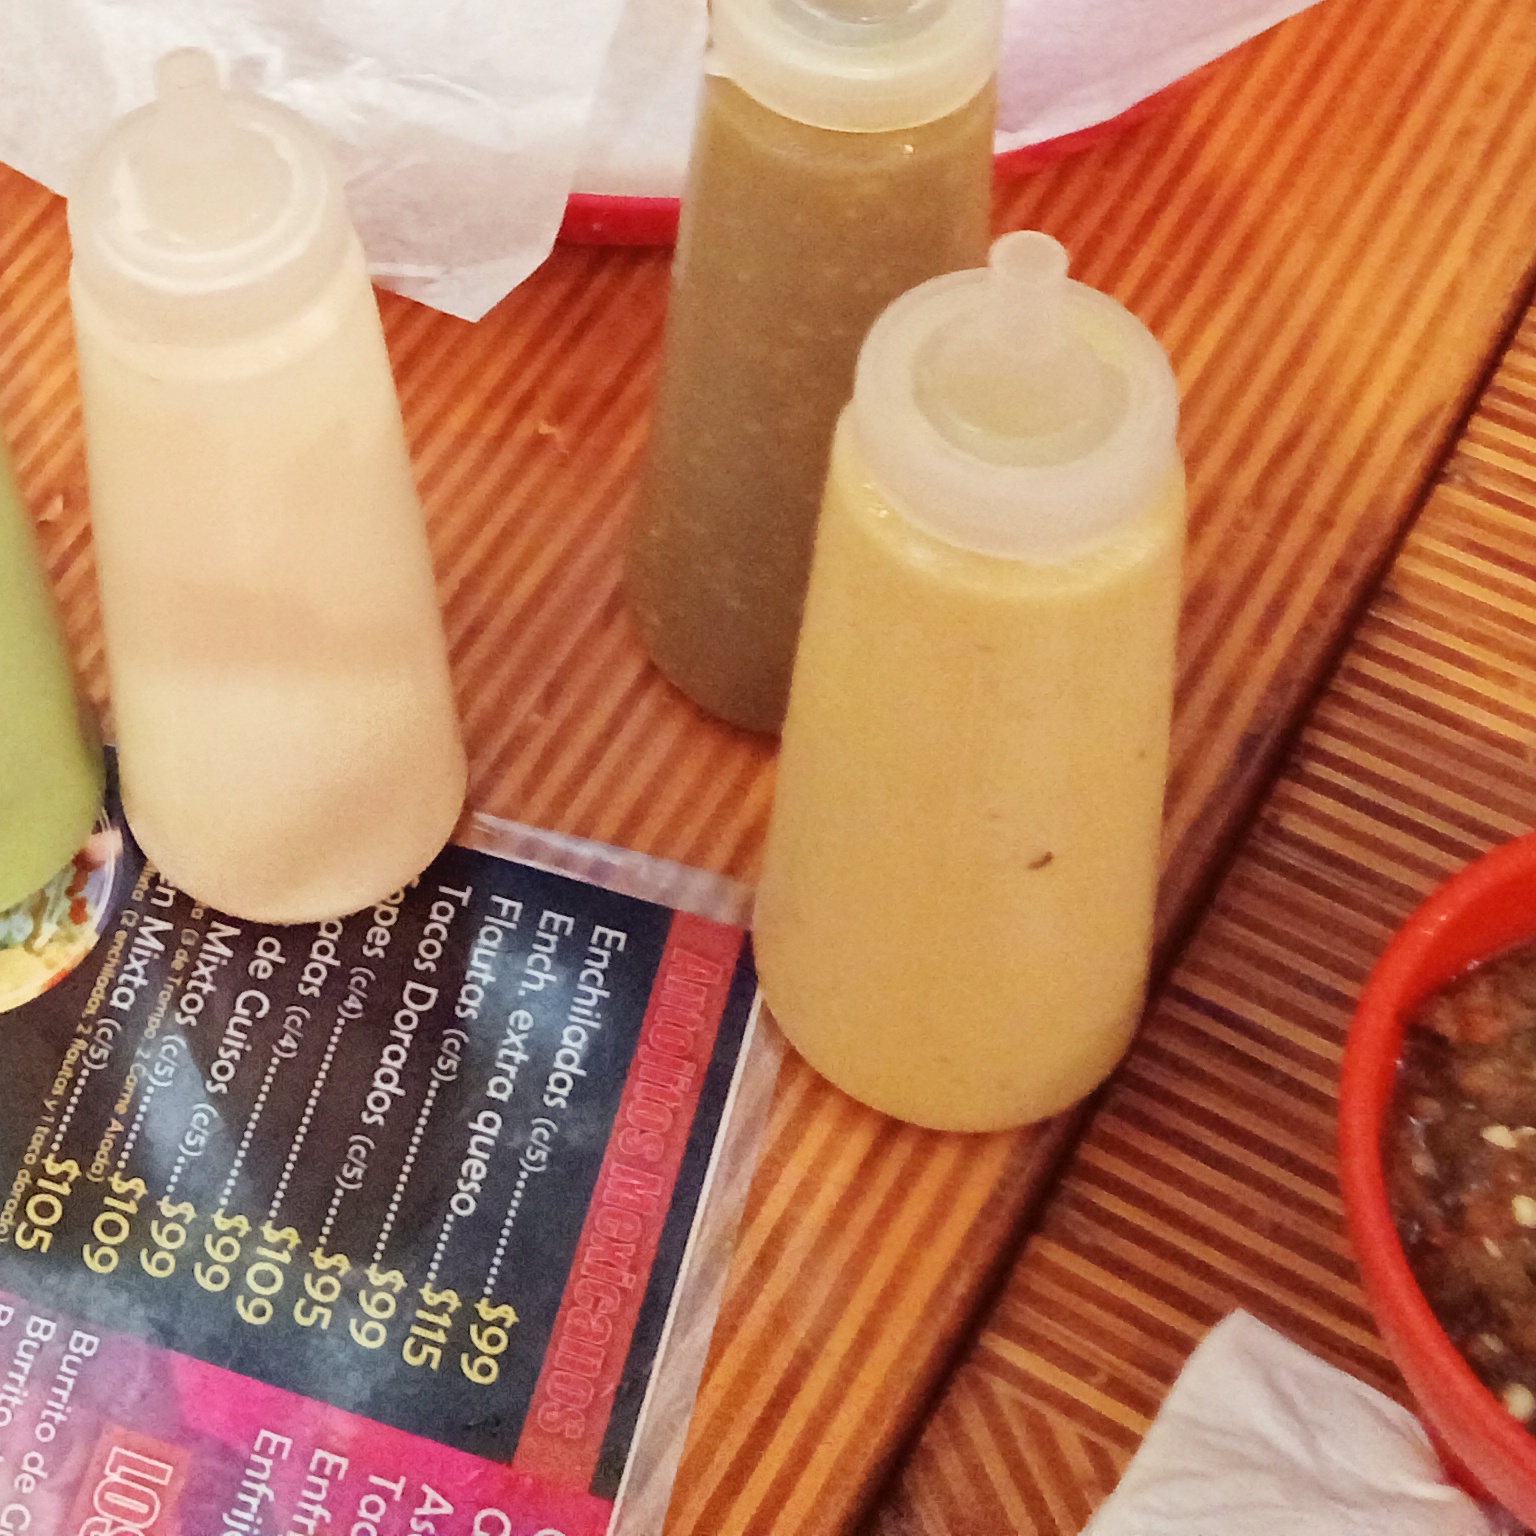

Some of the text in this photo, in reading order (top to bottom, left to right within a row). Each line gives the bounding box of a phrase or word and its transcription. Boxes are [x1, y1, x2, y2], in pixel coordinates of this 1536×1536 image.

[109, 915, 173, 1011] Mixta
[170, 948, 189, 971] de
[50, 1037, 88, 1096] flautas
[82, 1017, 122, 1070] (c/5)
[272, 1005, 311, 1058] (c/4)
[42, 1098, 58, 1111] y
[82, 920, 241, 1275] Mixtos (c/5) $109
[113, 1061, 148, 1115] Carne
[139, 936, 286, 1278] de Guisos (c/5) $99
[235, 867, 420, 1325] opes (c/4) $109
[292, 885, 472, 1330] Tacos Dorados (c/5) $95
[348, 894, 522, 1349] Flautas (c/5) $99
[22, 1125, 50, 1165] taco
[85, 1117, 124, 1182] Asada)
[401, 909, 575, 1370] Ench. extra queso $115
[460, 924, 626, 1385] Enchiladas (c/5) $99
[14, 1152, 81, 1253] $105
[530, 944, 726, 1441] Antojitos Mexicanos
[193, 1207, 251, 1292] $99
[33, 1329, 100, 1443] Burrito
[13, 1450, 48, 1494] de
